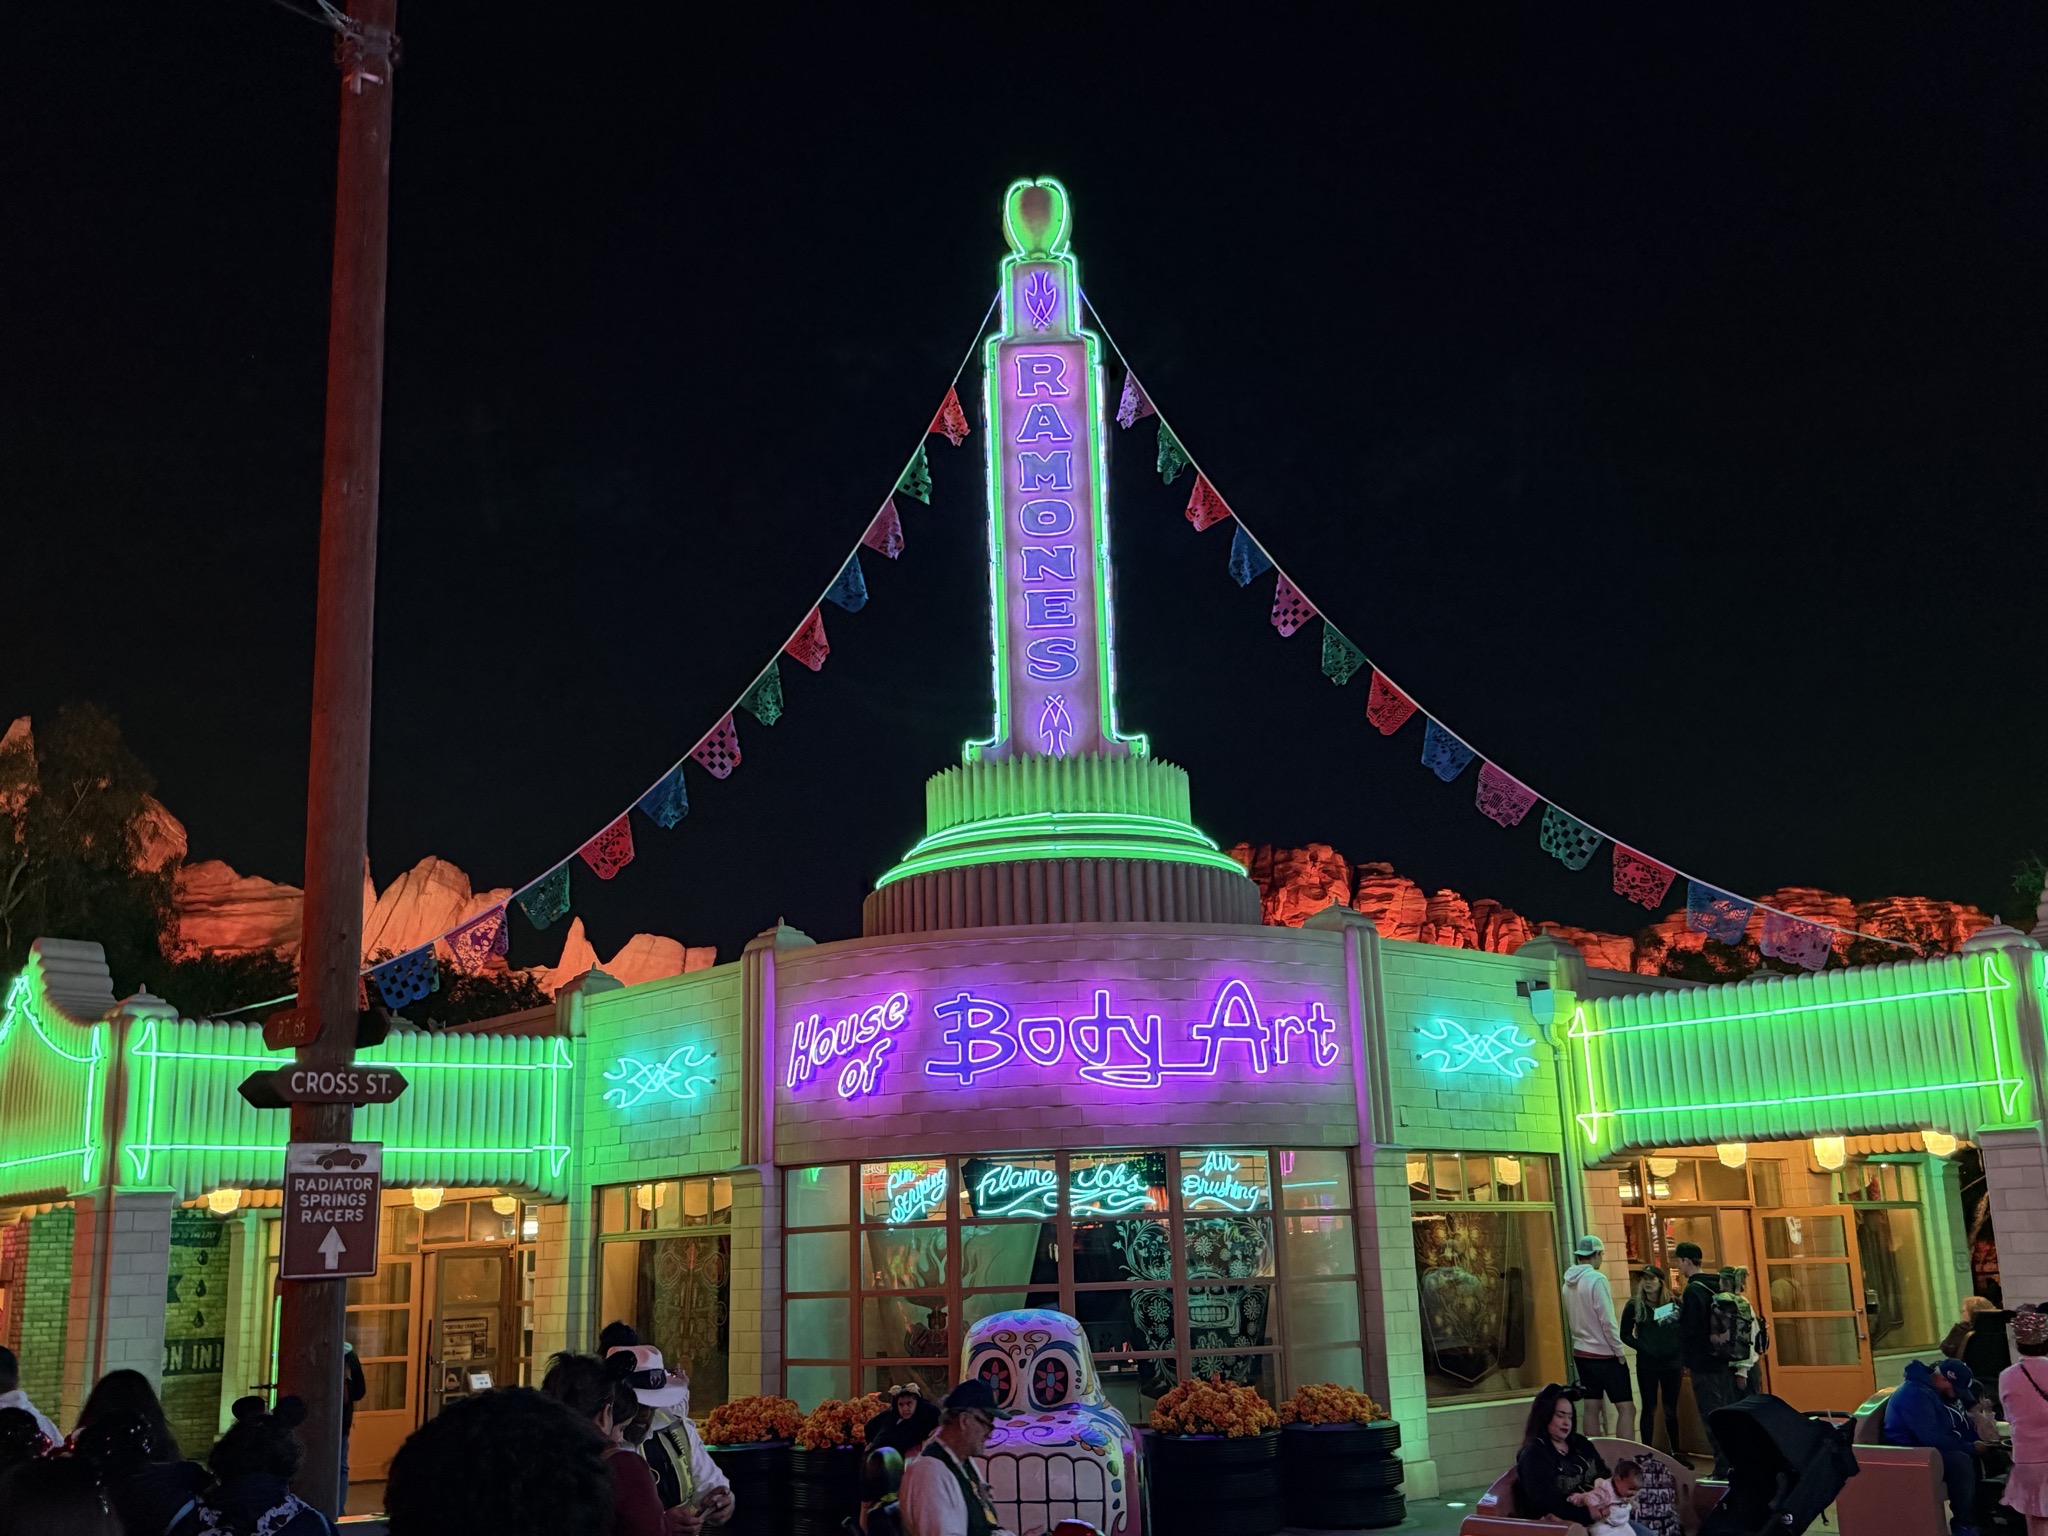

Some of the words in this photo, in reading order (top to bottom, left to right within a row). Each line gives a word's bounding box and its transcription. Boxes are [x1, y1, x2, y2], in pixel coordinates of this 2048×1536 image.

[1015, 354, 1079, 680] RAMONES
[293, 1016, 306, 1038] 66
[786, 991, 909, 1088] House
[925, 990, 1161, 1089] Body
[1193, 980, 1340, 1076] Art
[838, 1037, 892, 1098] of
[291, 1071, 360, 1095] CROSS
[365, 1073, 393, 1095] ST.
[1199, 1151, 1241, 1177] Air
[294, 1178, 373, 1192] RADIATOR
[976, 1164, 1060, 1207] Flame
[1077, 1162, 1150, 1192] Jobs
[1181, 1174, 1260, 1211] Brushing
[299, 1193, 367, 1208] SPRINGS
[301, 1209, 364, 1223] RACERS
[191, 1343, 222, 1370] IN!
